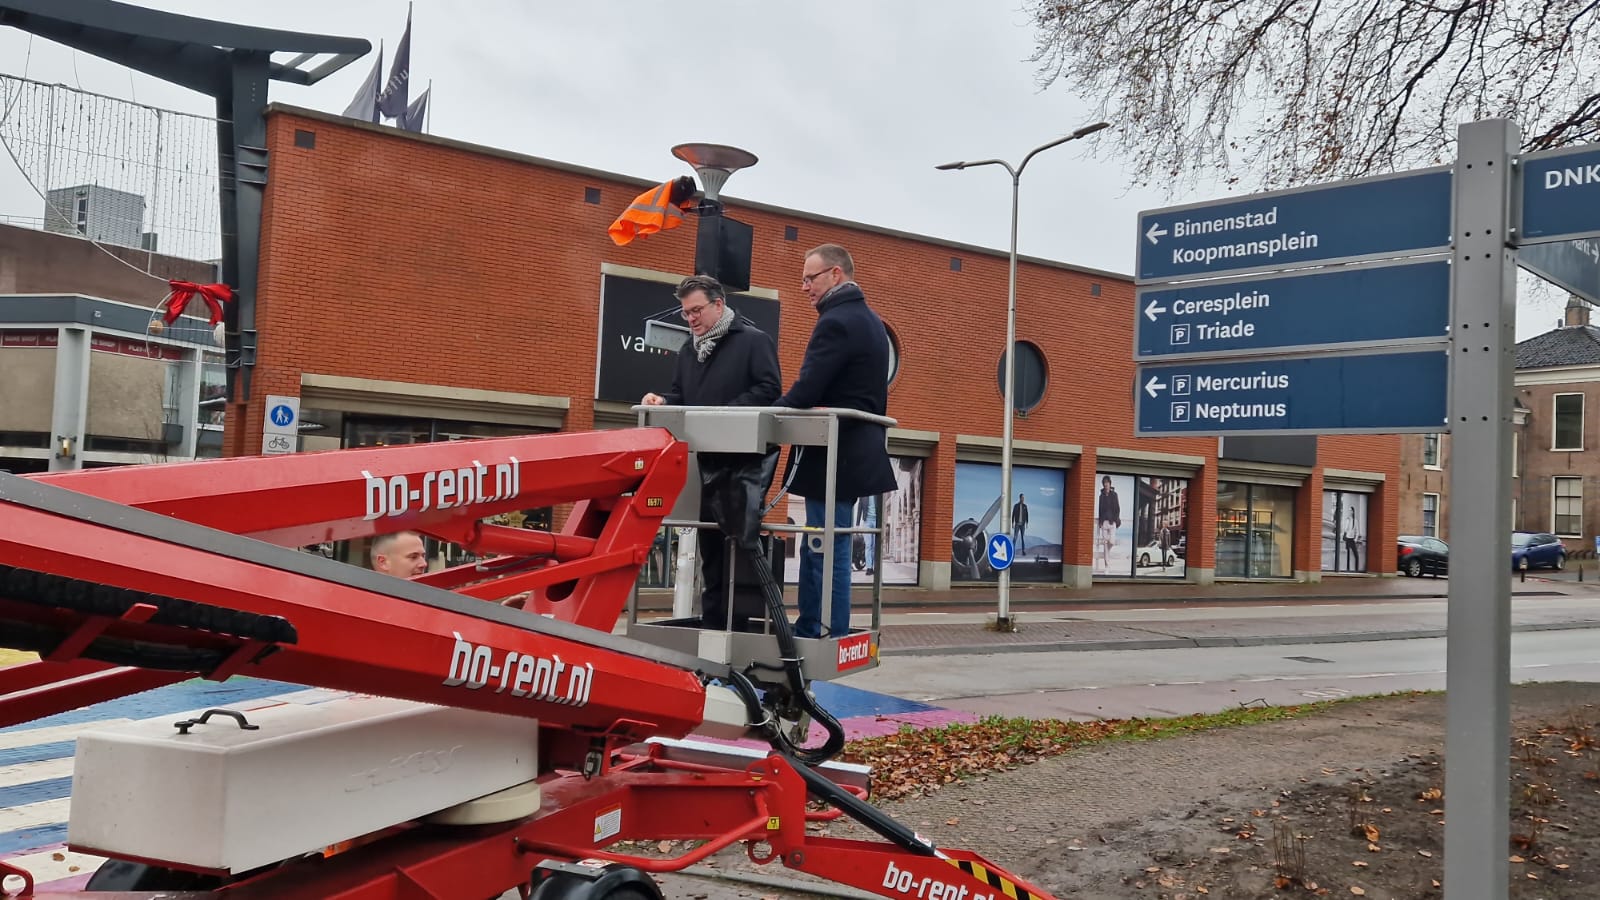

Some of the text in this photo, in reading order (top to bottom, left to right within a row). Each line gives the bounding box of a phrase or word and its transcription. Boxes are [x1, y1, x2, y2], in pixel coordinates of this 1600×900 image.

[1544, 164, 1600, 189] DNK
[1174, 206, 1278, 238] Binnenstad
[1172, 231, 1318, 264] Koopmansplein
[1173, 290, 1270, 315] Ceresplein
[1196, 319, 1255, 340] Triade
[1196, 371, 1289, 392] Mercurius
[1195, 403, 1287, 423] Neptunus
[361, 456, 520, 521] bo-rent.nl
[838, 639, 869, 665] bo-rent.nl
[442, 631, 594, 708] bo-rent.nl
